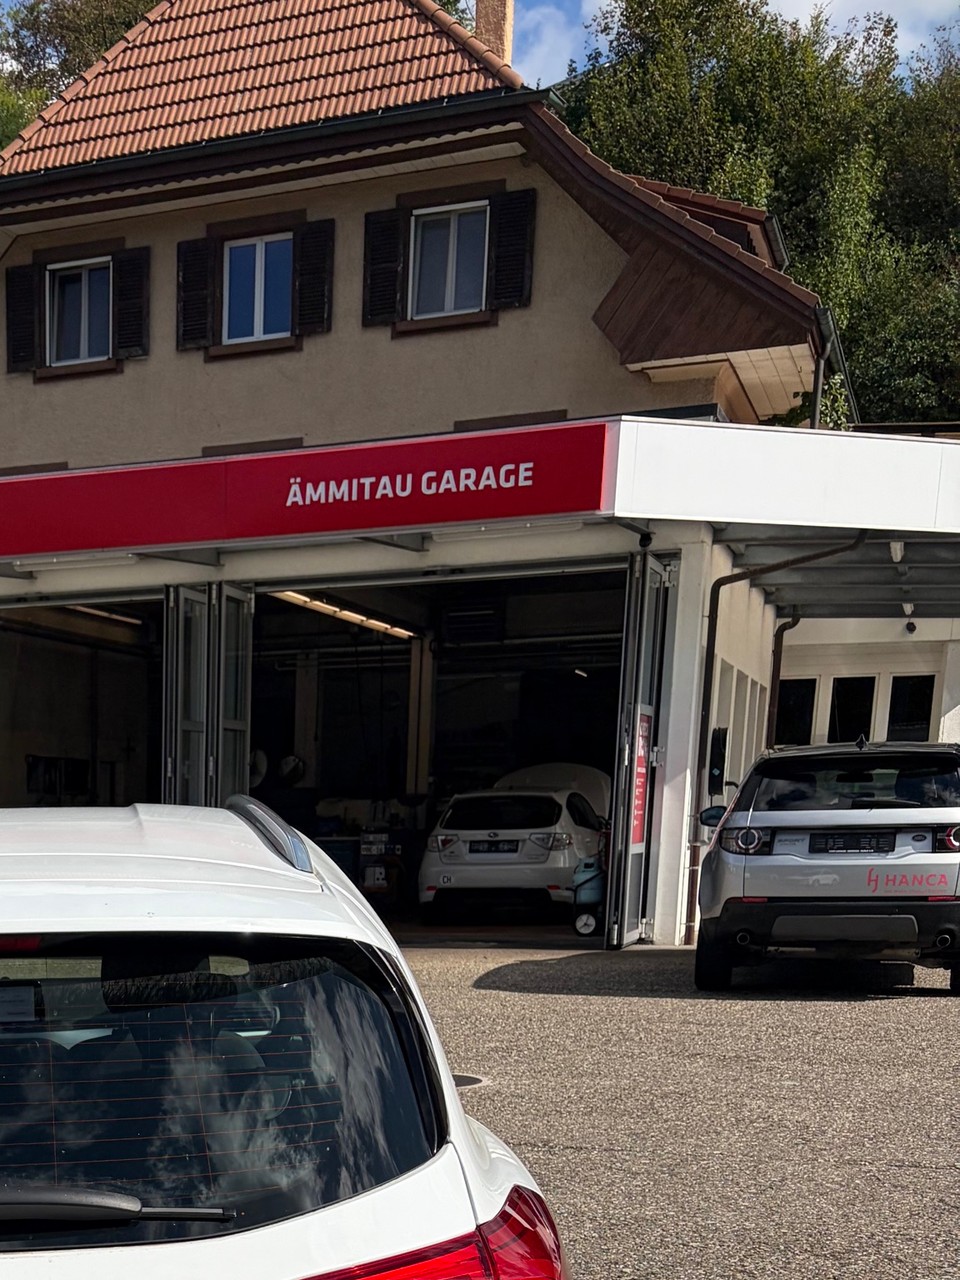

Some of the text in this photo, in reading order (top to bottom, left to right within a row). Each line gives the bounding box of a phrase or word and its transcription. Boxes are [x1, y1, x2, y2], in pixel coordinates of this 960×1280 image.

[286, 462, 534, 507] ÄMMITAU GARAGE
[442, 875, 452, 884] CH
[884, 873, 948, 887] HANCA
